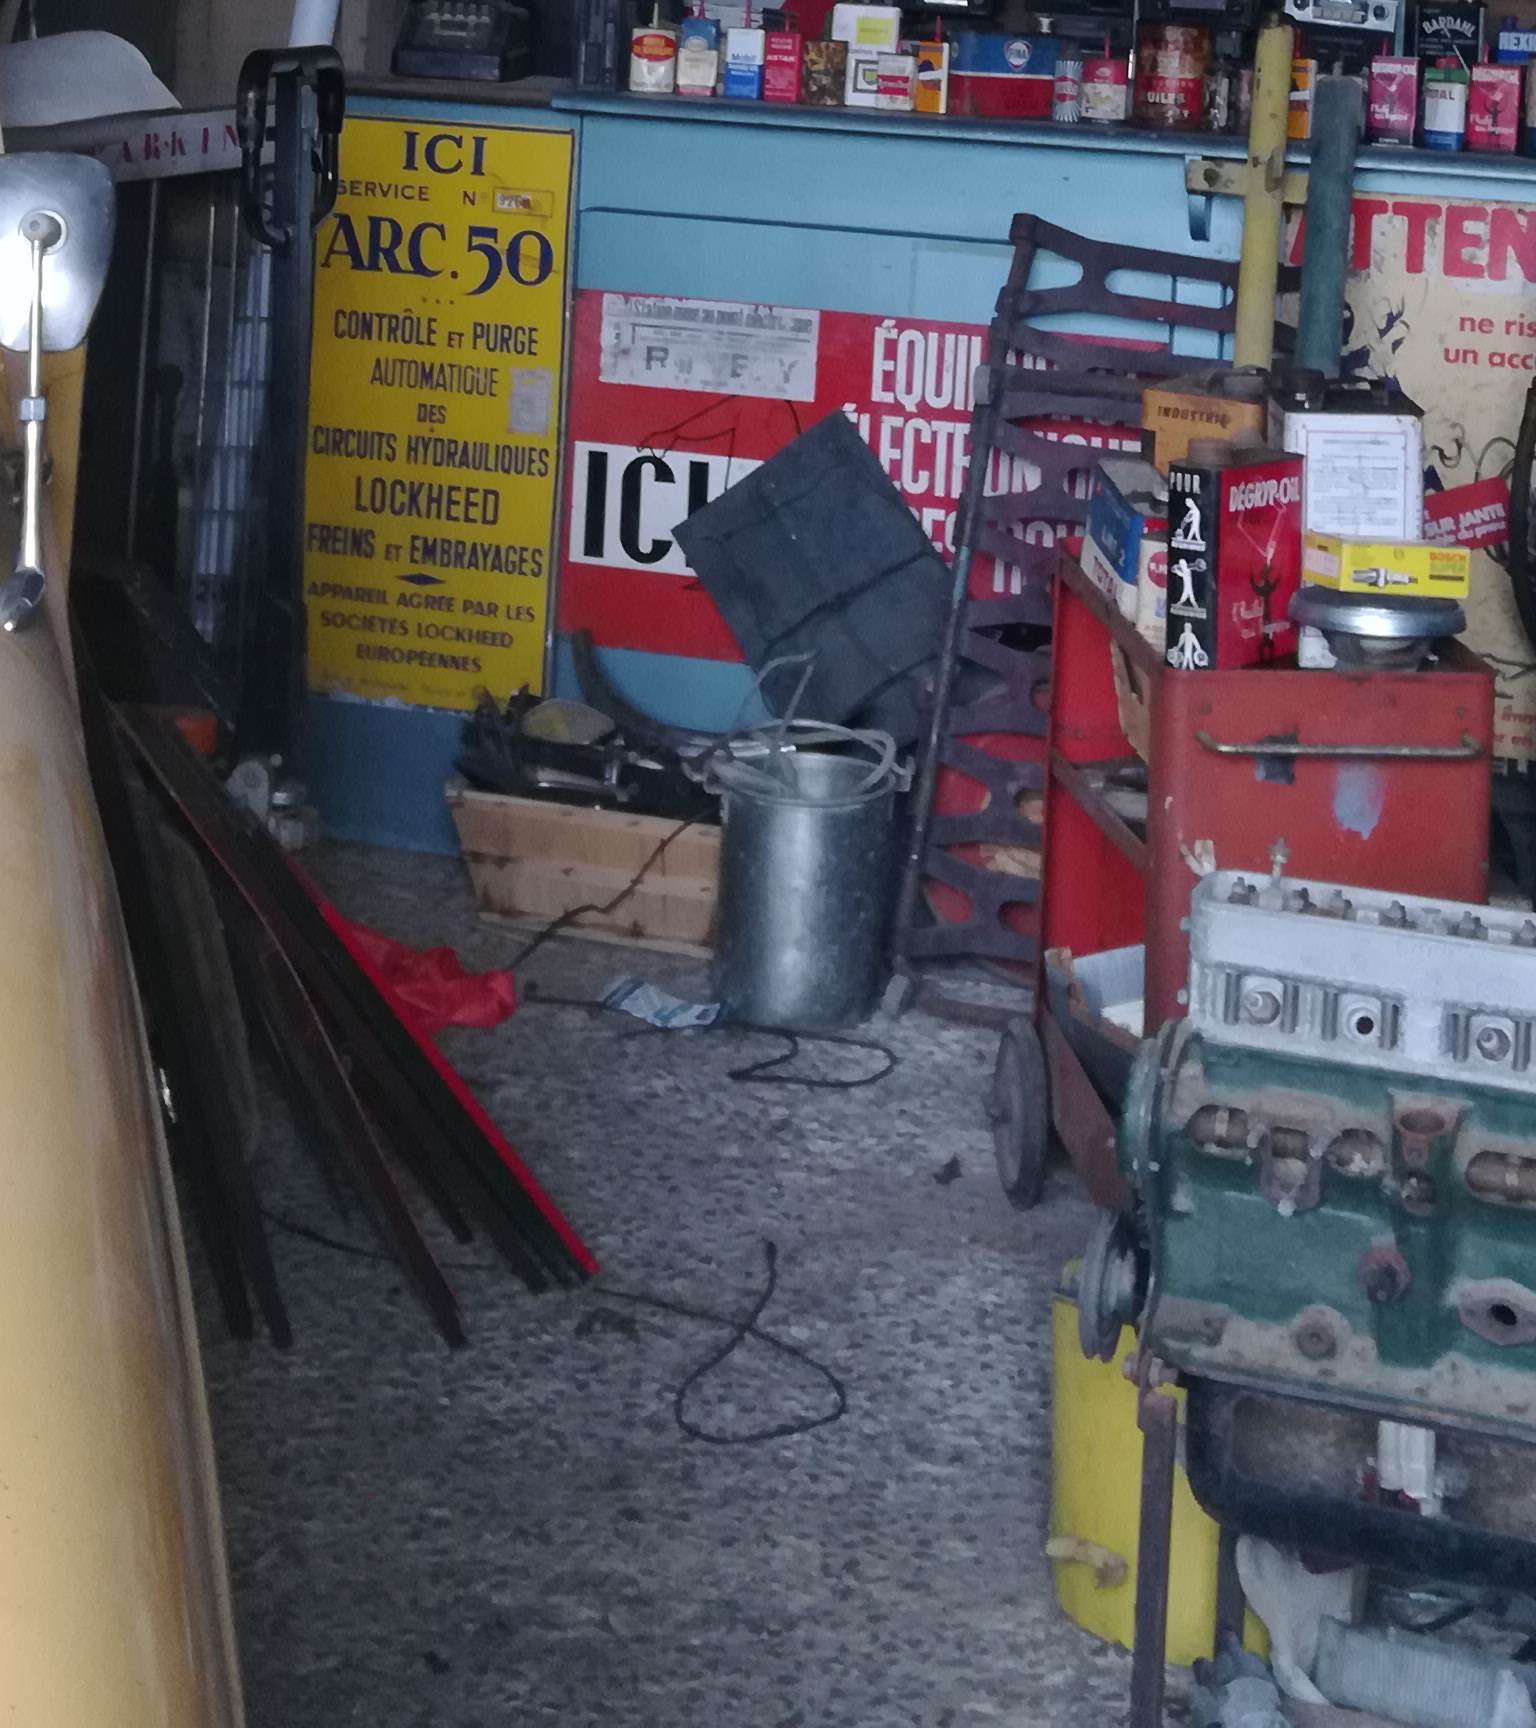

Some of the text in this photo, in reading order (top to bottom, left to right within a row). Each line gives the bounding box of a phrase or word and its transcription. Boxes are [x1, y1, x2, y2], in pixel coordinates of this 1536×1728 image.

[1421, 15, 1477, 39] BARDAHL
[402, 130, 489, 177] ICI
[335, 179, 431, 203] SERVICE
[332, 307, 539, 357] CONTRÔLE ET PURGE
[1458, 314, 1495, 334] ne
[369, 356, 500, 398] AUTOMATIQUE
[1443, 347, 1479, 365] un
[416, 402, 448, 426] DES
[311, 425, 550, 479] CIRCUITS HYDRAULIQUES
[354, 475, 501, 527] LOCKHEED
[307, 522, 544, 579] FREINS ET EMBRAYAGES
[307, 581, 389, 607] APPAREIL
[462, 599, 500, 621] PAR
[505, 604, 537, 623] LES
[416, 622, 515, 650] LOCKHEED
